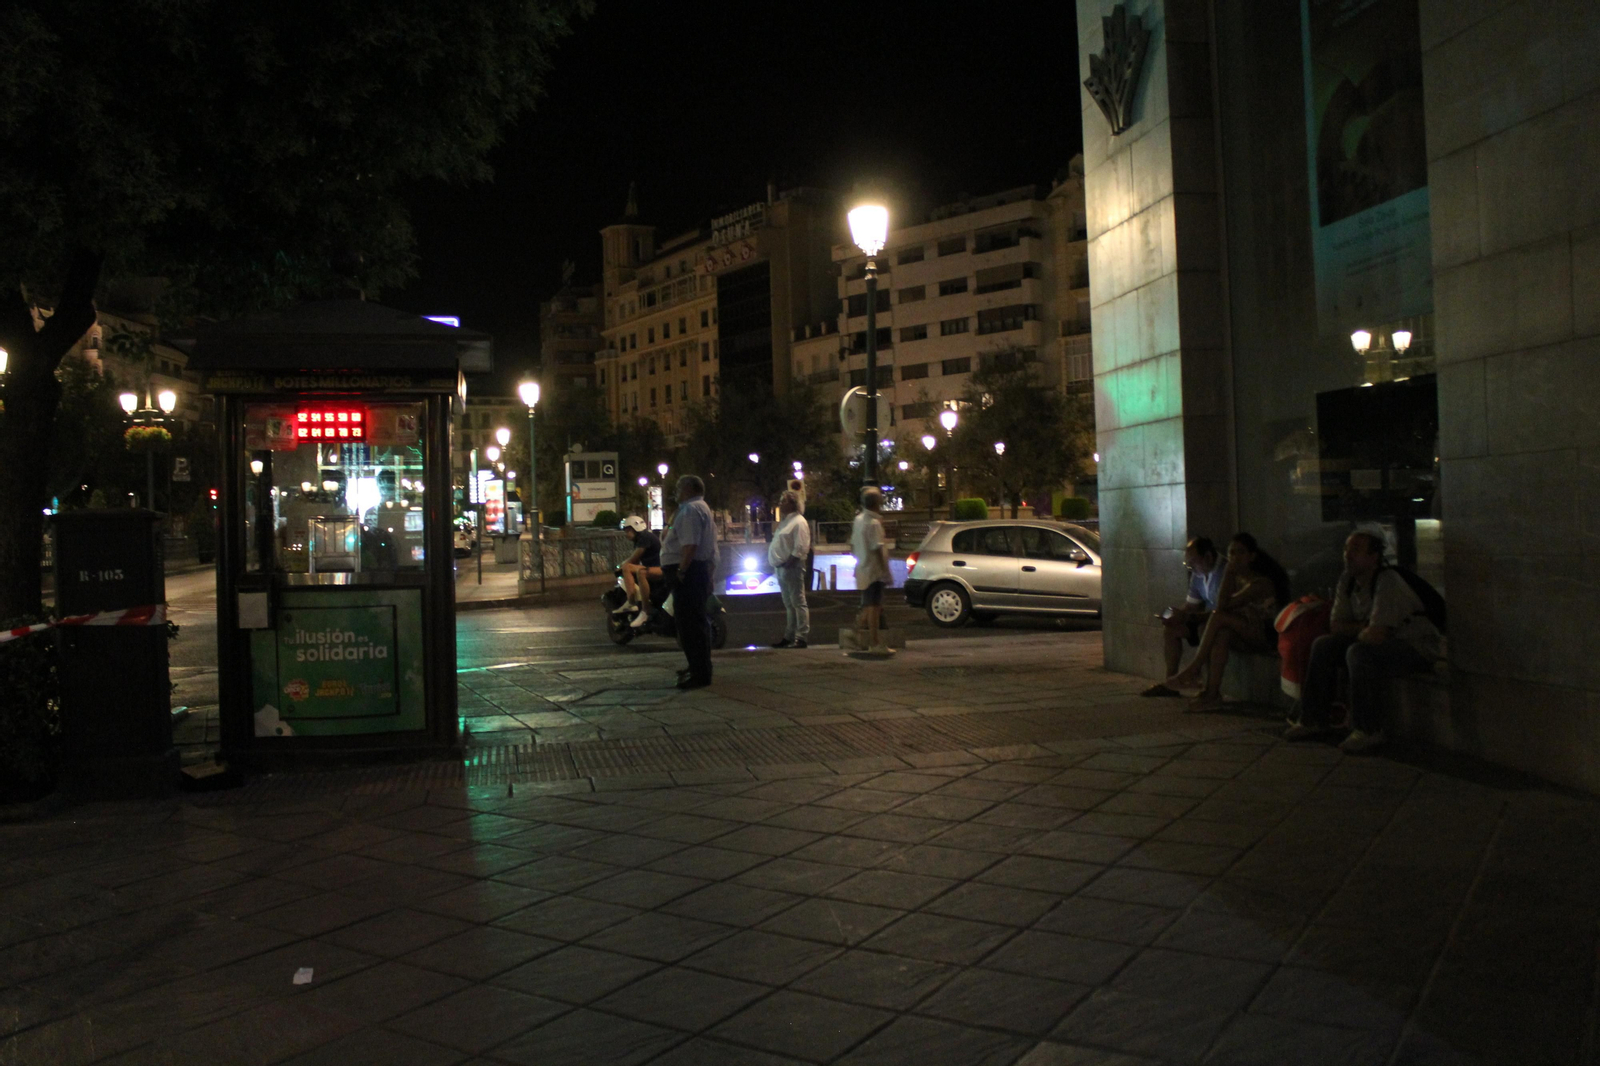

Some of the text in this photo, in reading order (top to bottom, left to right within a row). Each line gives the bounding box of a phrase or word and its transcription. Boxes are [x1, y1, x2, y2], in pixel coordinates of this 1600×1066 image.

[274, 376, 412, 389] BOTES MILLONARIOS
[603, 464, 614, 475] Q
[295, 628, 356, 644] ilusión
[296, 642, 388, 662] solidaria
